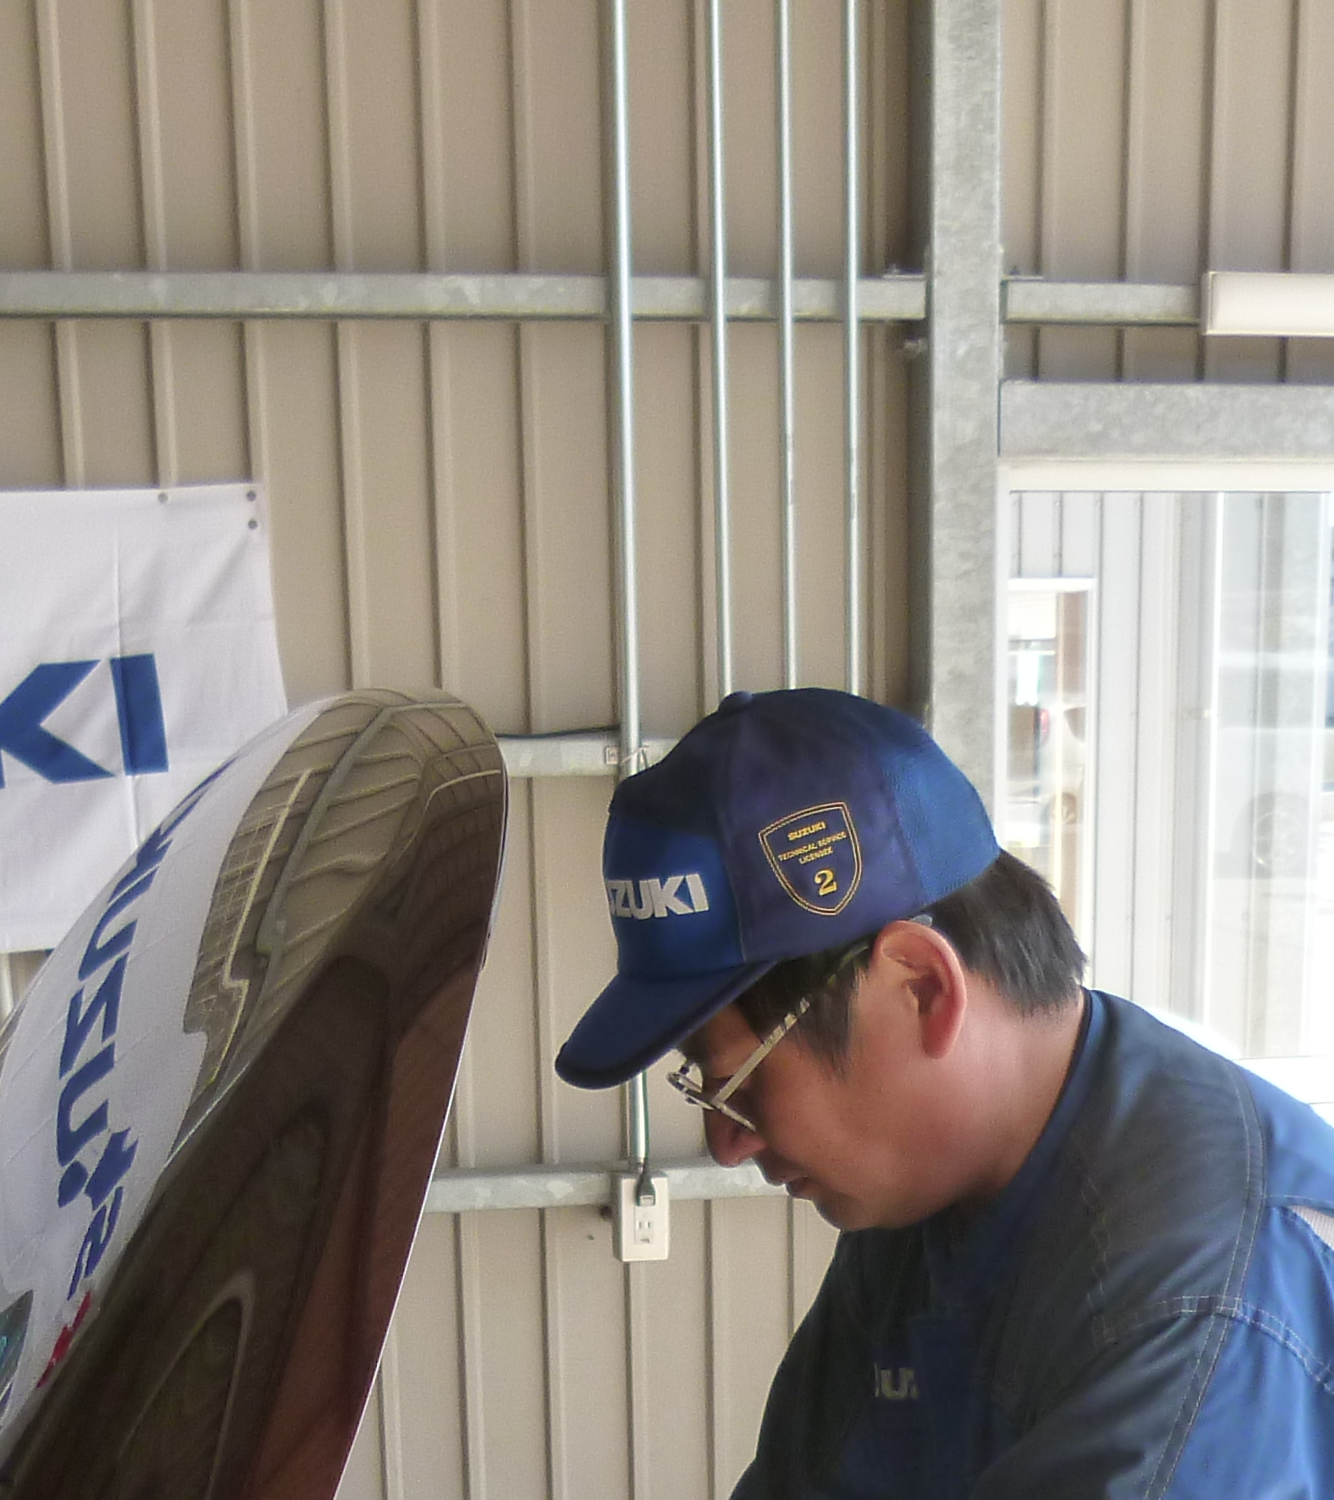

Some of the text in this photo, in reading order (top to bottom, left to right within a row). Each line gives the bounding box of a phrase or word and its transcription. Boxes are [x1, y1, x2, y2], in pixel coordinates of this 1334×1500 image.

[787, 821, 826, 841] SUZUKI
[778, 831, 847, 862] TECHNICAL SERVICE
[814, 869, 838, 896] 2
